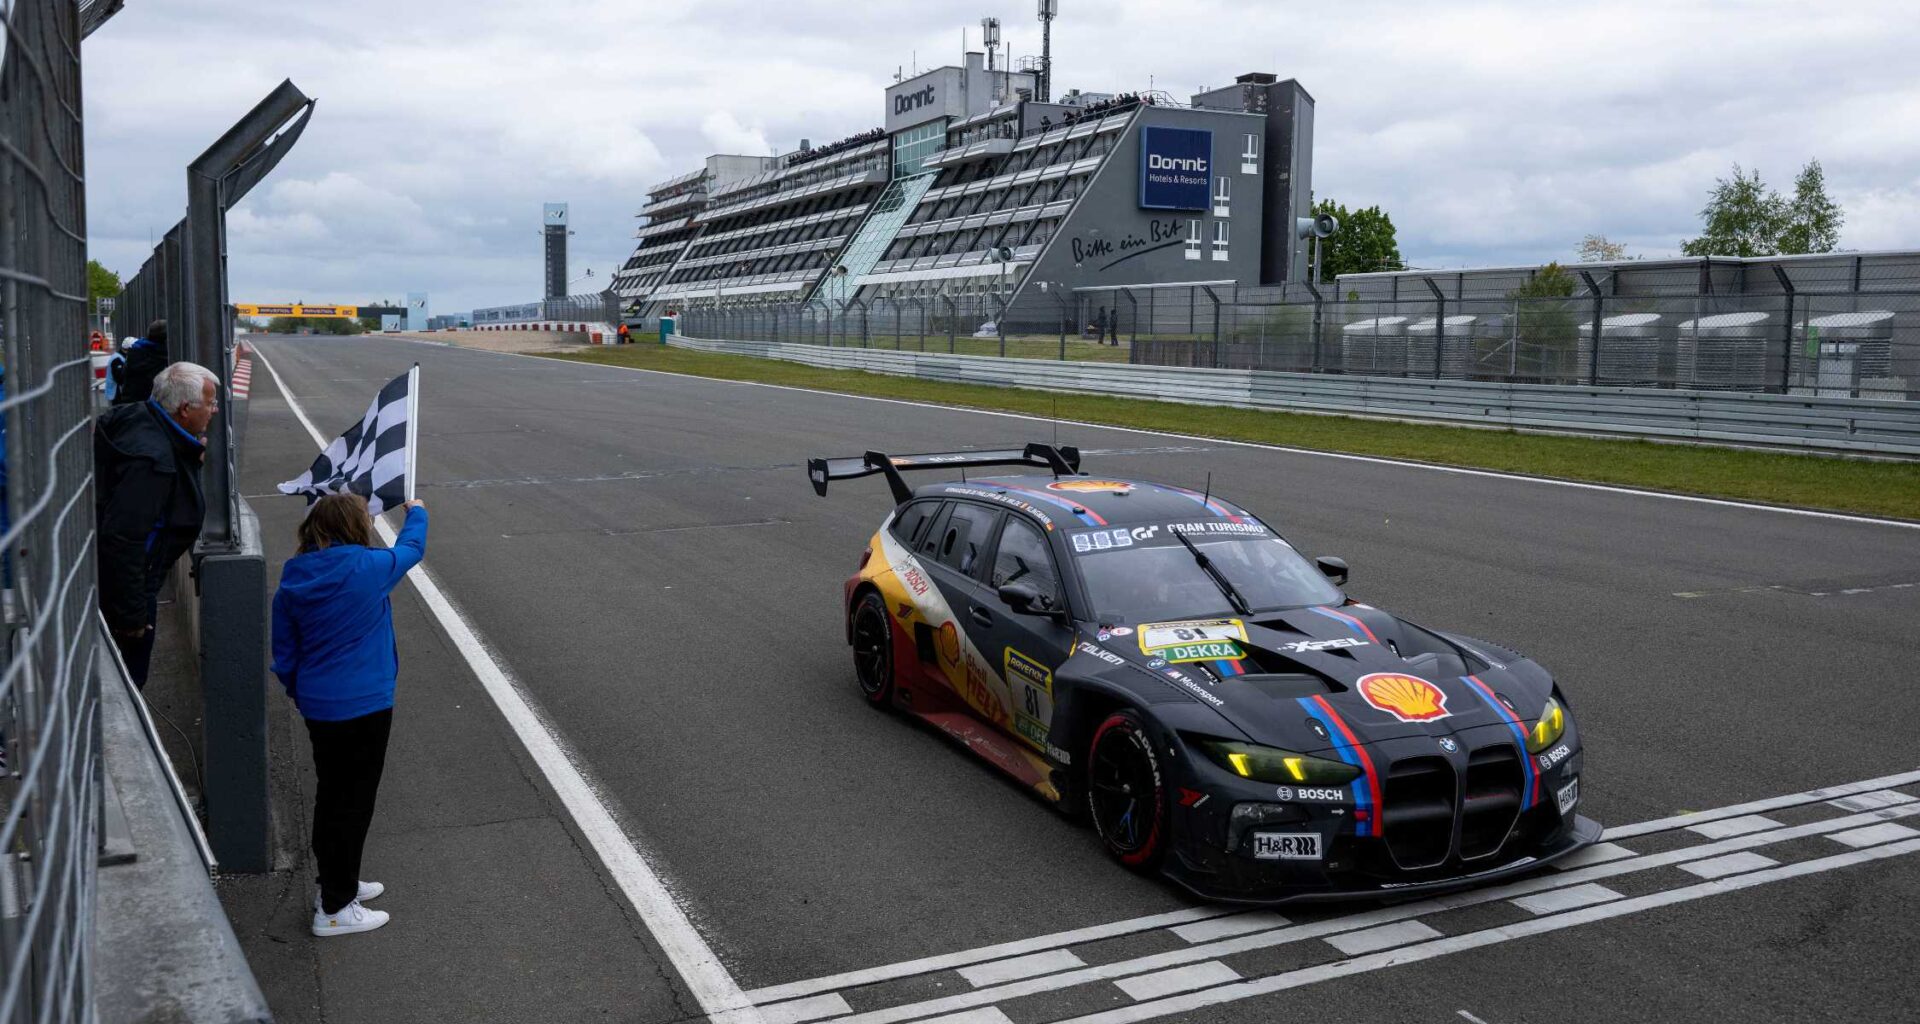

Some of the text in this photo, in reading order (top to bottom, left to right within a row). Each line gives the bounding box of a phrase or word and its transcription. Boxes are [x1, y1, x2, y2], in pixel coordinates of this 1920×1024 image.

[894, 84, 935, 116] Dorint
[1149, 154, 1208, 172] Dorint
[1149, 174, 1208, 185] Hotels & Resorts
[1072, 219, 1183, 263] Bitte ein Bit
[1166, 522, 1264, 534] GRAN TURISMO
[903, 568, 929, 597] BOSCH
[1173, 628, 1208, 642] 81
[1284, 637, 1371, 653] XPEL
[1077, 641, 1126, 666] FALKEN
[1174, 643, 1239, 660] DEKRA
[966, 652, 988, 686] Shell
[1010, 656, 1045, 682] RAVENOL
[1180, 675, 1225, 707] Motorsport
[1025, 684, 1040, 720] 81
[1029, 726, 1049, 747] DEK
[1135, 729, 1162, 787] ADVAN
[1548, 744, 1571, 763] BOSCH
[1298, 788, 1344, 801] BOSCH
[1258, 836, 1294, 855] H&R
